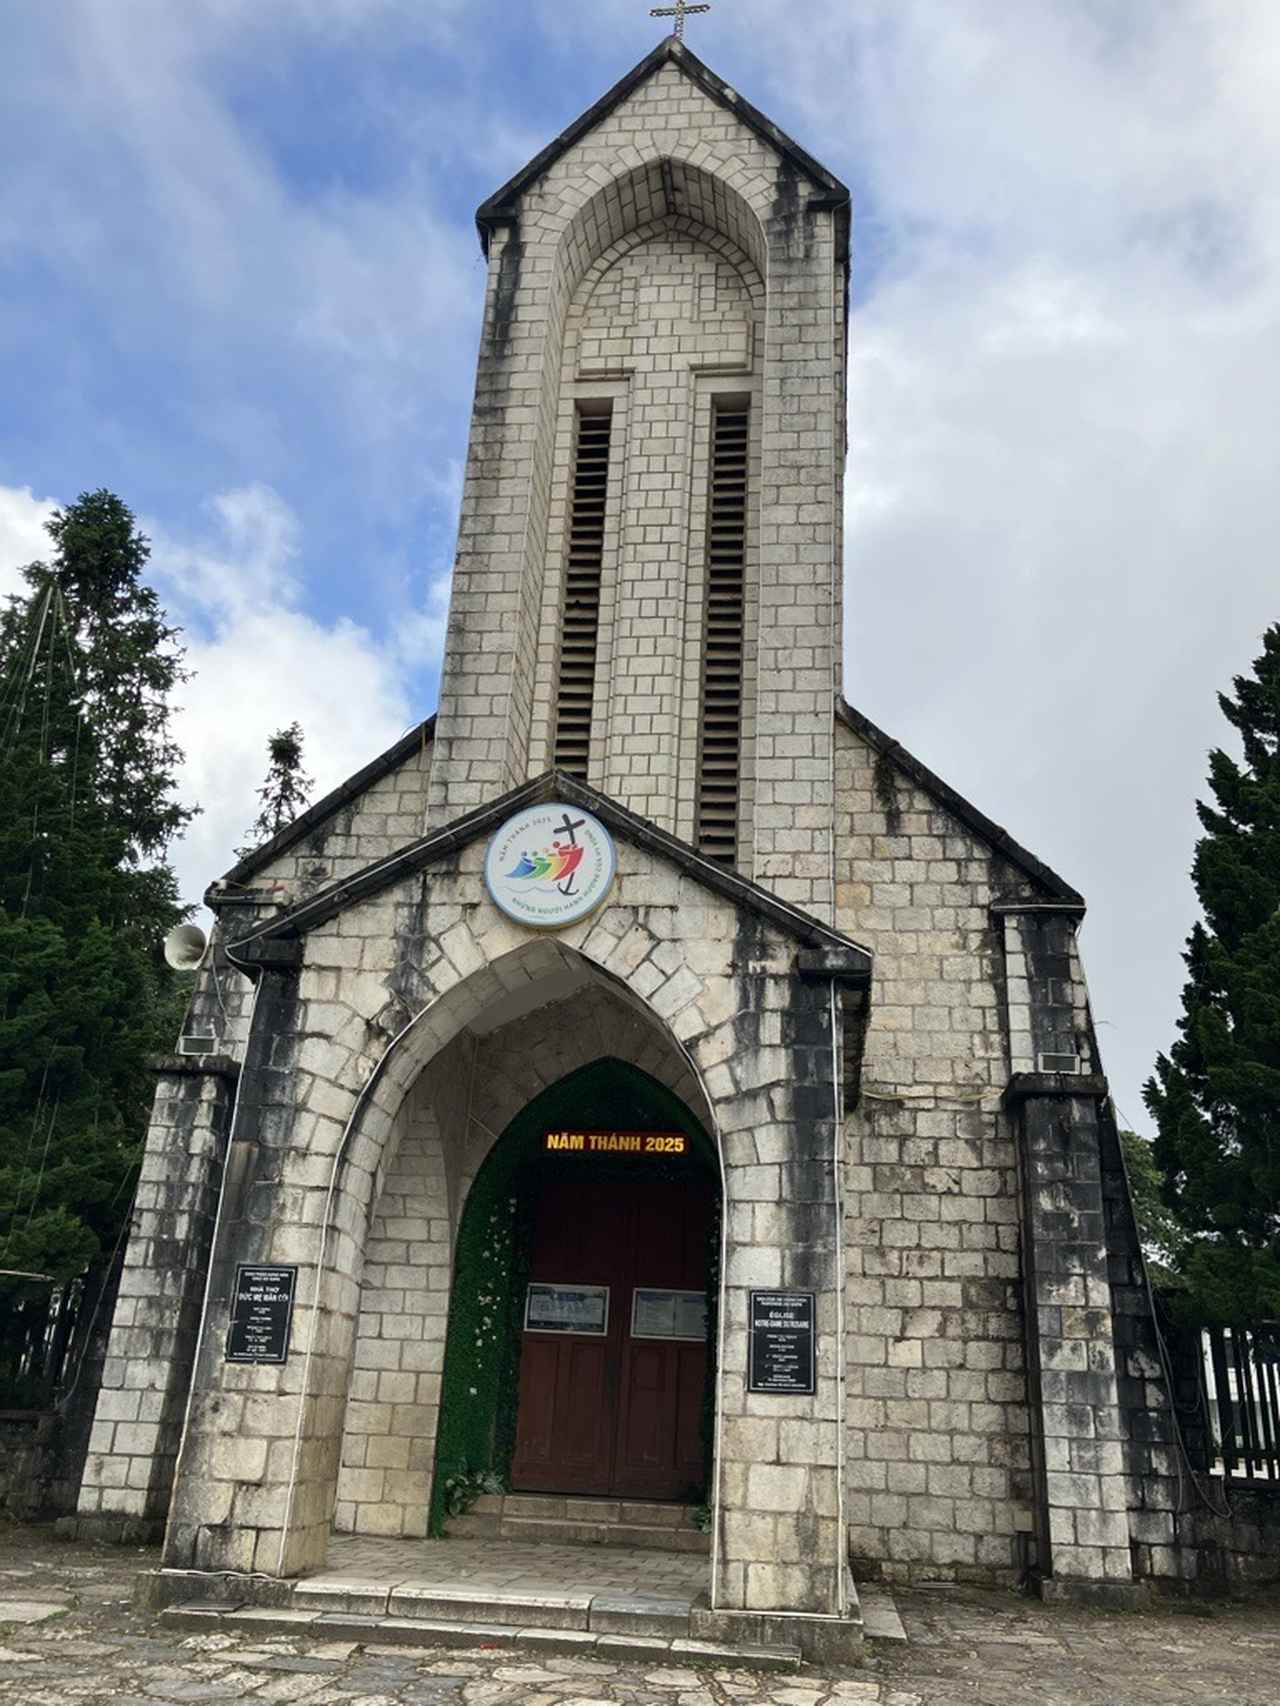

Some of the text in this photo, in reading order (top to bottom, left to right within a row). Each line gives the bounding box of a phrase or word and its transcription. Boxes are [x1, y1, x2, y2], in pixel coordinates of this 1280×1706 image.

[547, 1132, 685, 1152] NĂM THÁNH 2025
